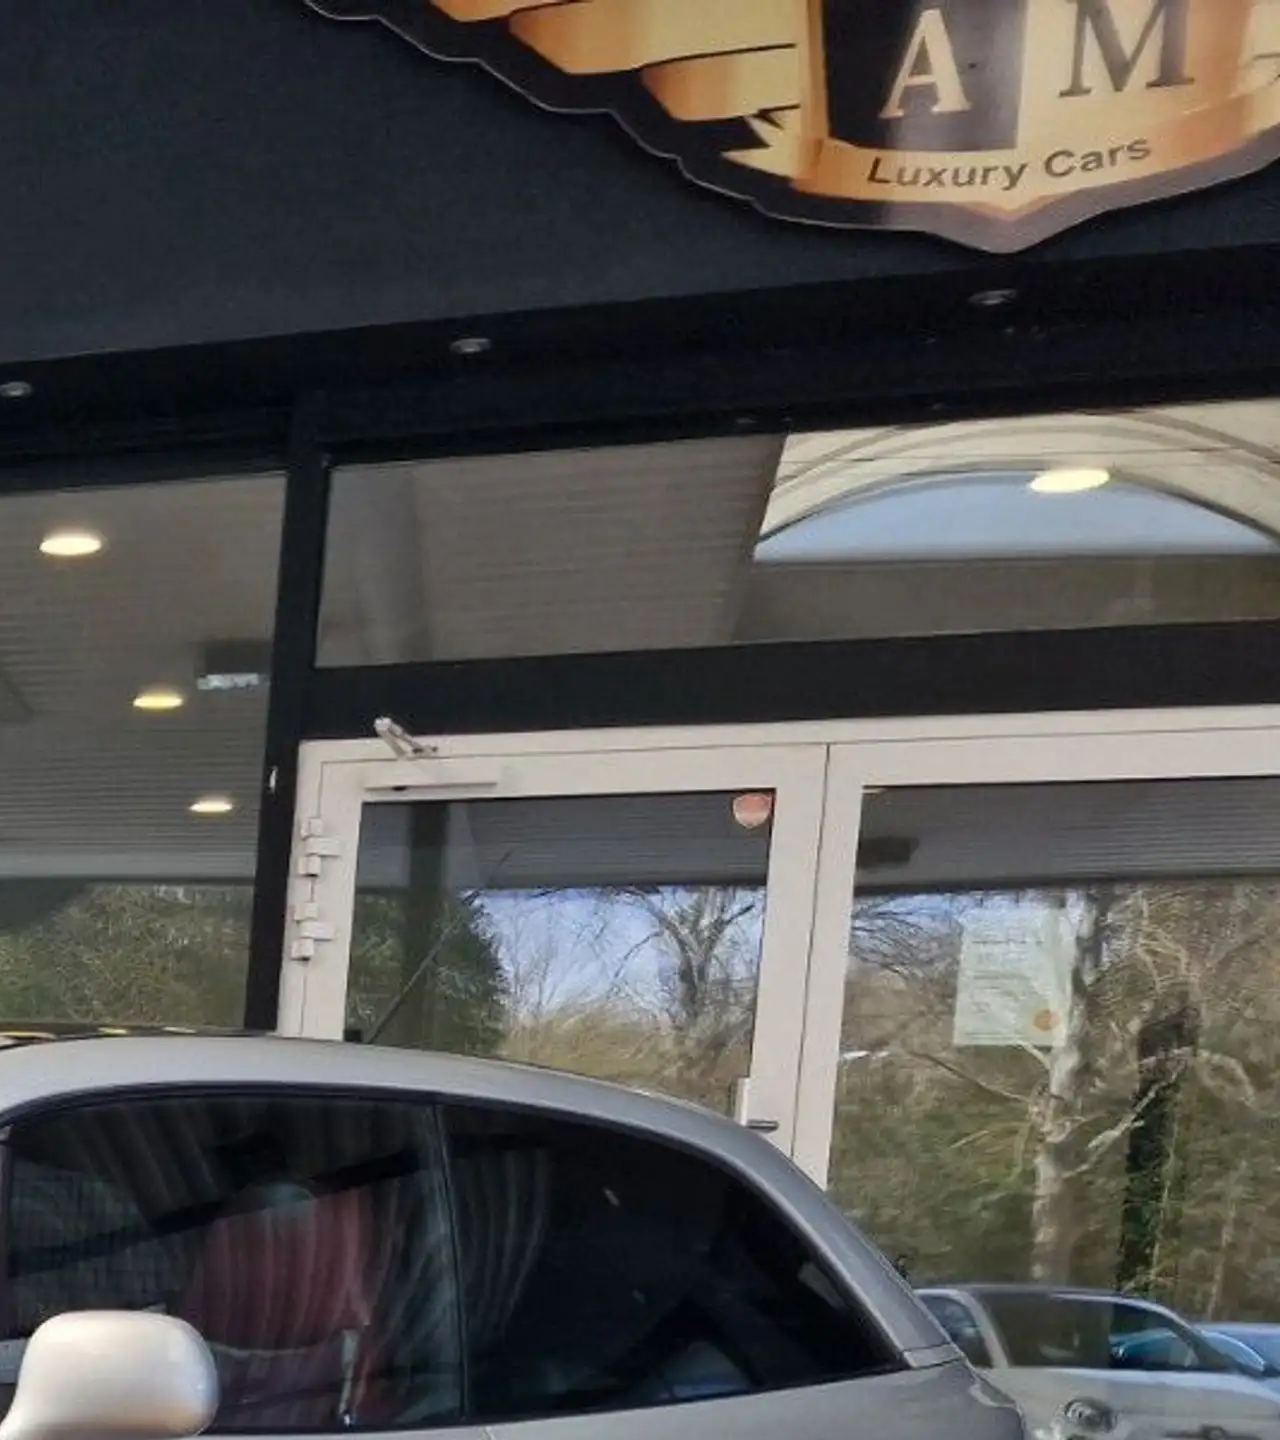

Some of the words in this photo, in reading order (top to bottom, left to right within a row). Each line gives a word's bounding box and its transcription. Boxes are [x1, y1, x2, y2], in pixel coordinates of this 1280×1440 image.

[878, 8, 973, 119] A
[1058, 0, 1196, 98] M
[867, 156, 1028, 191] Luxury
[1044, 137, 1151, 178] Cars
